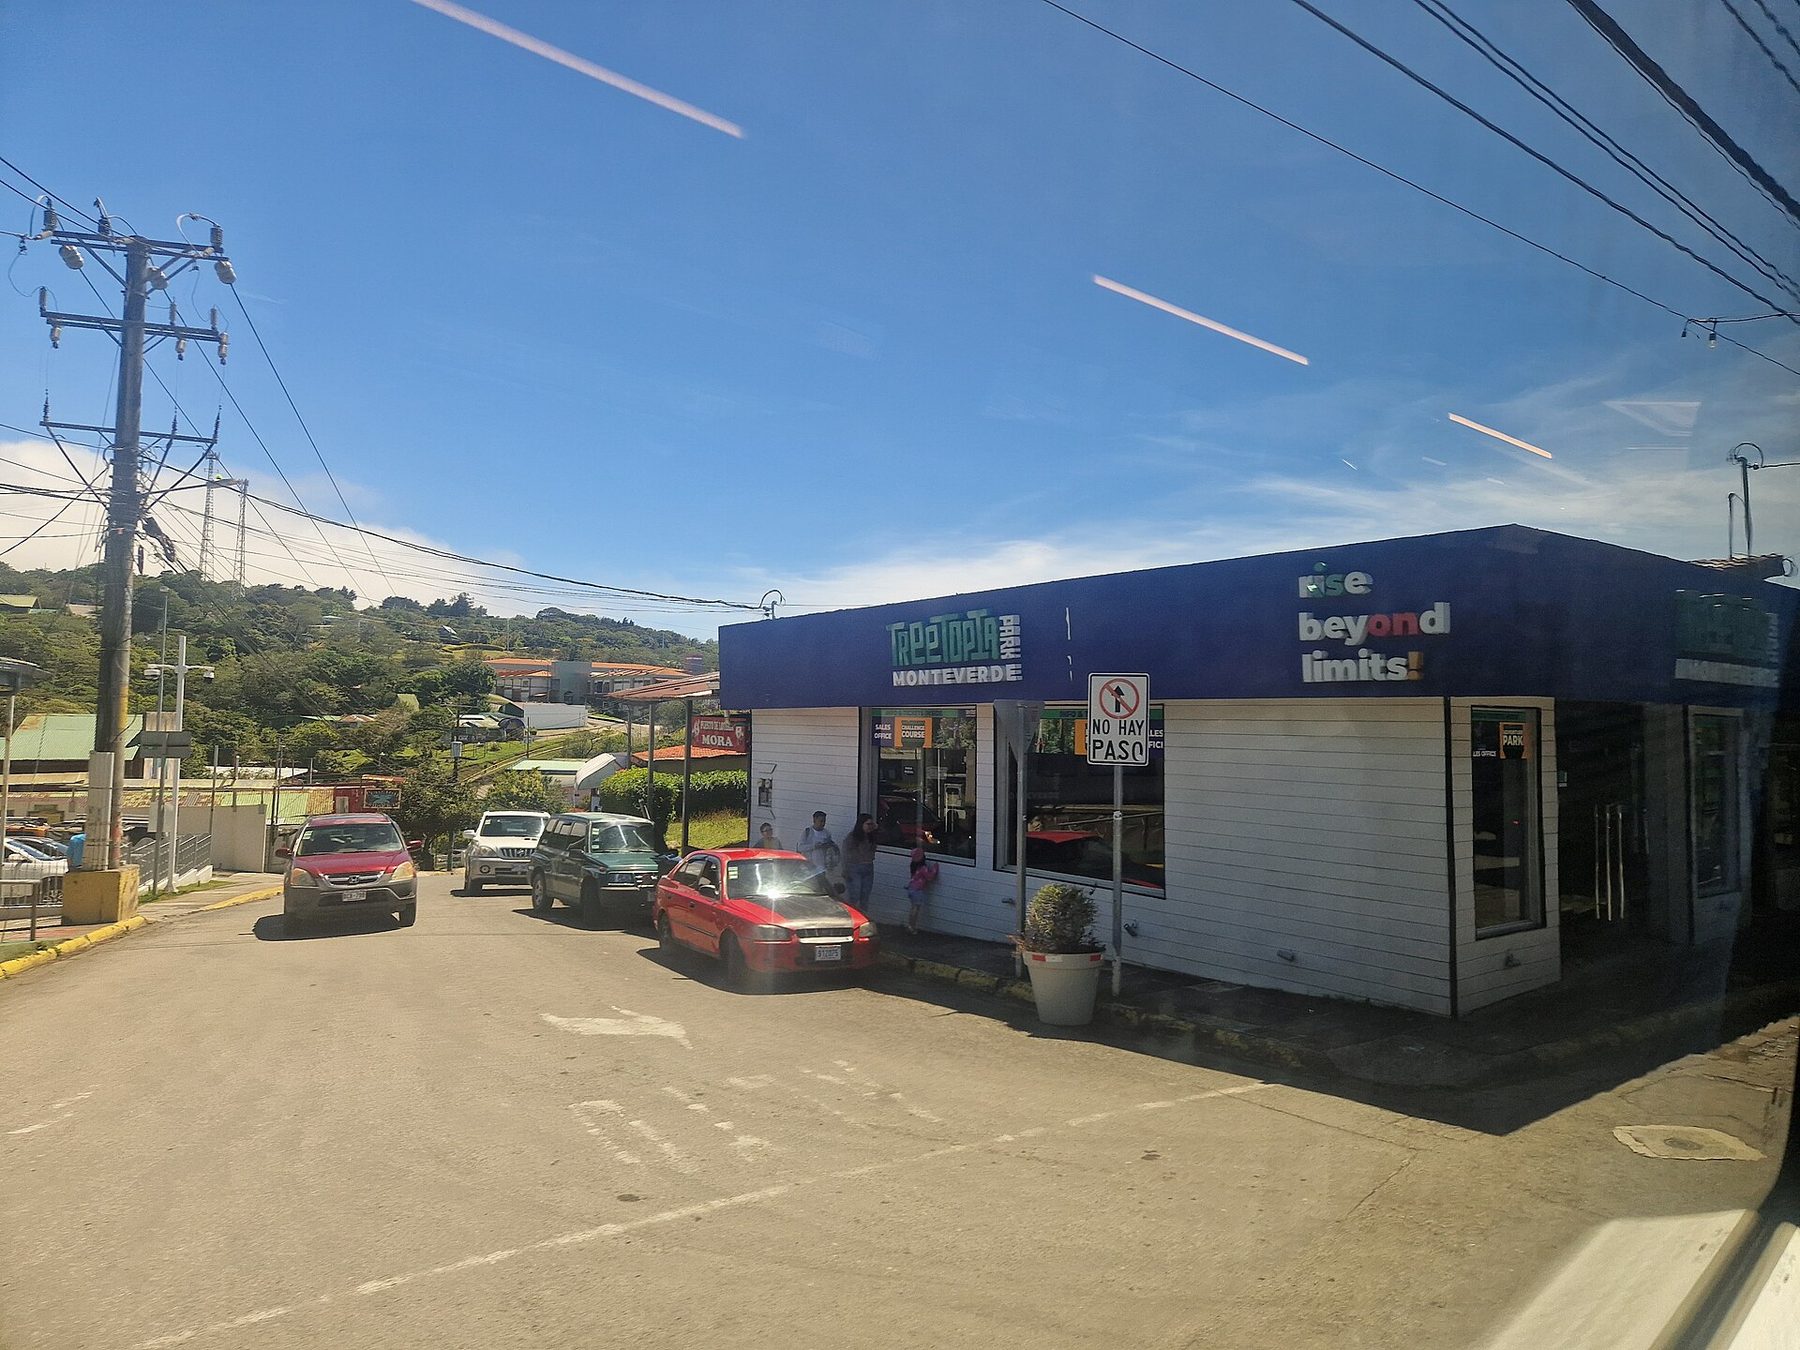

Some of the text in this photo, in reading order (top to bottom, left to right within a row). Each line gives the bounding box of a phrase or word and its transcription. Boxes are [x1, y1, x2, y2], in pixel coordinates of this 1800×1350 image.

[1298, 561, 1374, 598] rise
[1298, 602, 1451, 646] beyond
[999, 614, 1022, 660] PARK
[1302, 648, 1424, 683] limits!
[892, 663, 1024, 687] MONTEVERDE
[875, 723, 891, 731] SALES
[901, 730, 925, 738] COURSE
[1092, 719, 1145, 736] NO HAY
[1149, 729, 1164, 737] LES
[702, 734, 734, 747] MORA
[874, 732, 892, 740] OFFICE
[1503, 735, 1524, 746] PARK
[1092, 739, 1144, 761] PASO
